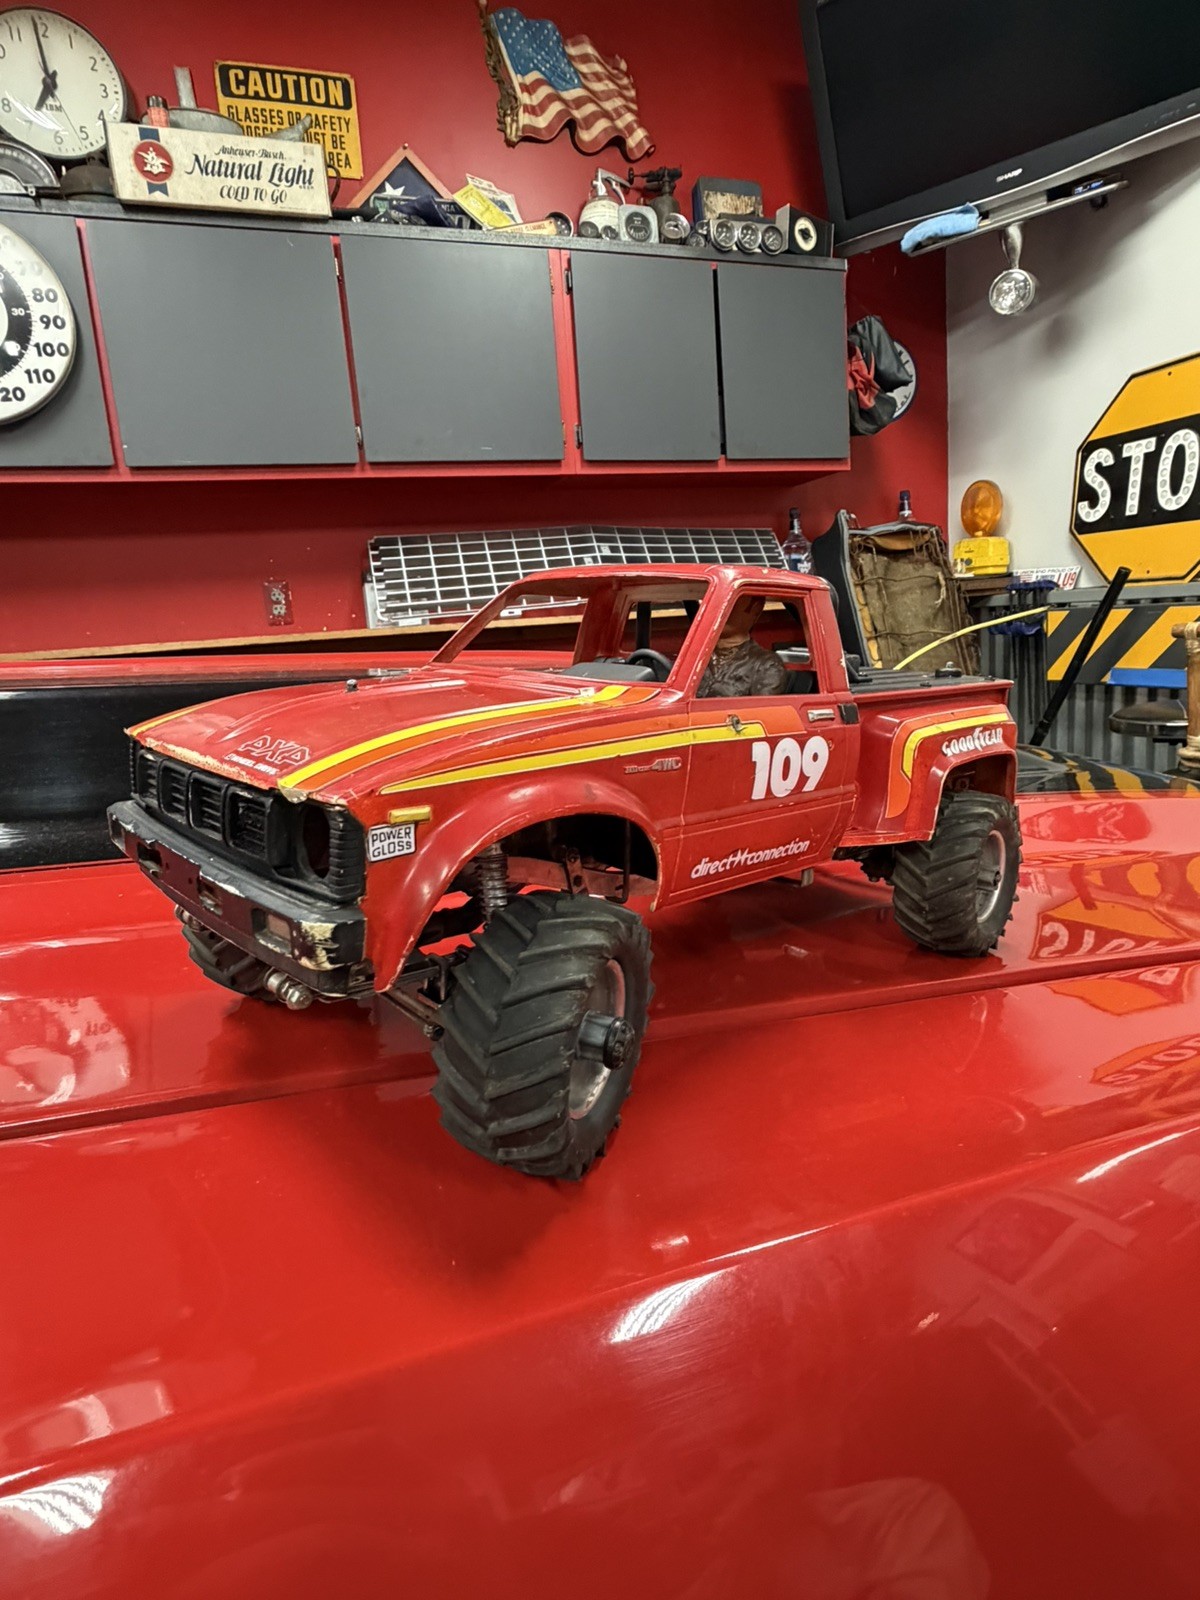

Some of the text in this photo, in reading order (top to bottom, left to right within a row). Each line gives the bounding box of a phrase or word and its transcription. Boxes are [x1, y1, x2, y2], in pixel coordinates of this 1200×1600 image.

[89, 56, 98, 72] 2
[99, 83, 109, 98] 3
[228, 68, 345, 107] CAUTION
[227, 105, 284, 125] GLASSES
[80, 126, 89, 141] 5
[302, 130, 326, 146] UST
[331, 133, 346, 150] BE
[328, 151, 352, 169] REA
[185, 153, 314, 188] Natural Light
[220, 185, 287, 204] COLD TO GO
[32, 287, 58, 303] 80
[11, 307, 25, 316] 30
[39, 314, 66, 330] 90
[34, 342, 70, 357] 100
[24, 368, 56, 384] 110
[0, 386, 26, 402] 20
[1077, 428, 1200, 523] STO
[751, 735, 829, 801] 109
[371, 826, 412, 847] POWER
[372, 840, 412, 858] GLOSS
